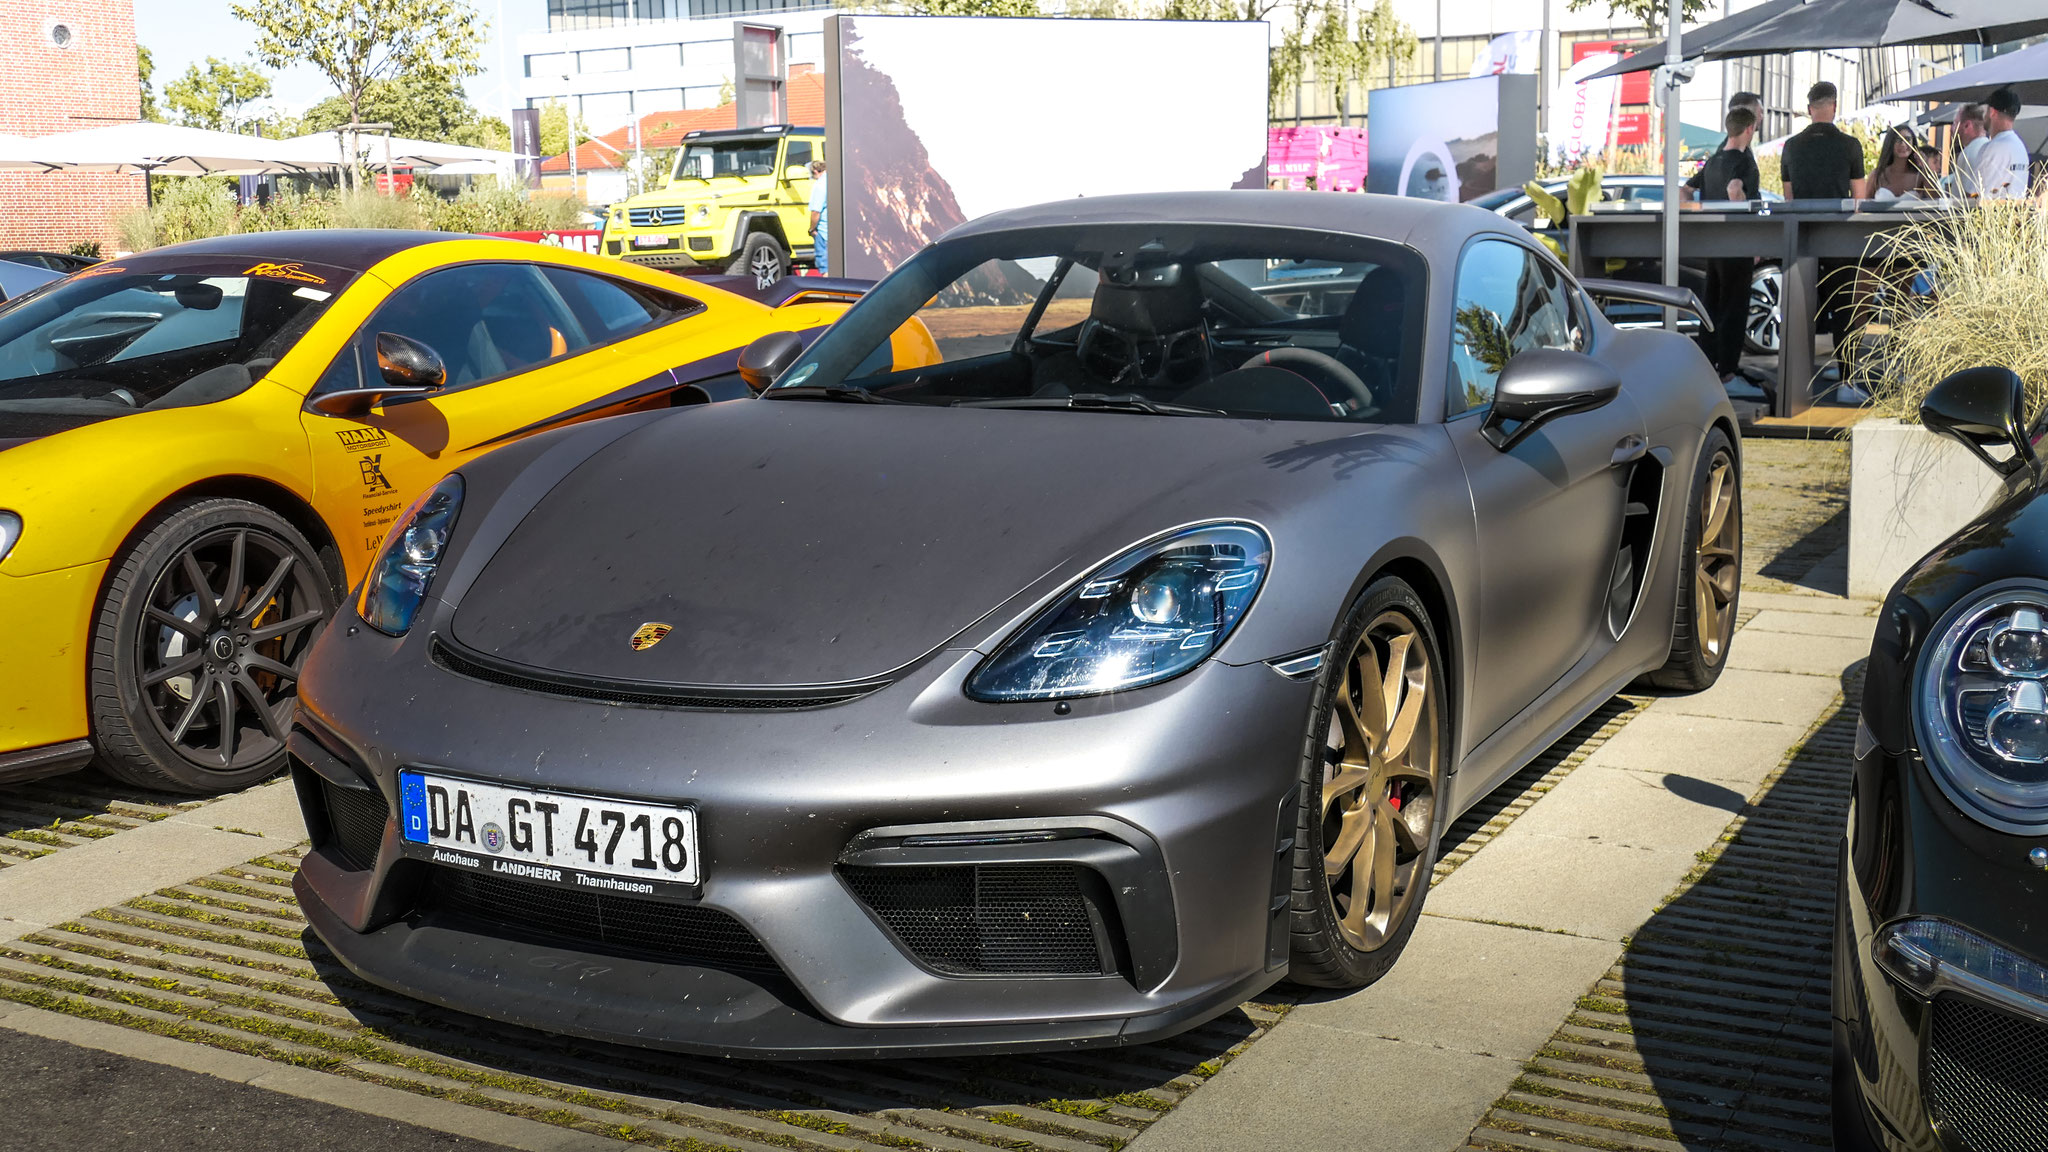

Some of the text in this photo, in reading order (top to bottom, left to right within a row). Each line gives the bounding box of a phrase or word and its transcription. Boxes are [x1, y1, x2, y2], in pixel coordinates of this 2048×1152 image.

[338, 427, 386, 445] HAAK
[346, 440, 387, 451] MOTORSPORT
[363, 502, 401, 517] Speedyshirt
[411, 815, 421, 831] D
[427, 785, 688, 873] DA GT 4718
[433, 850, 654, 894] Autohaus LANDHERR Thannhausen
